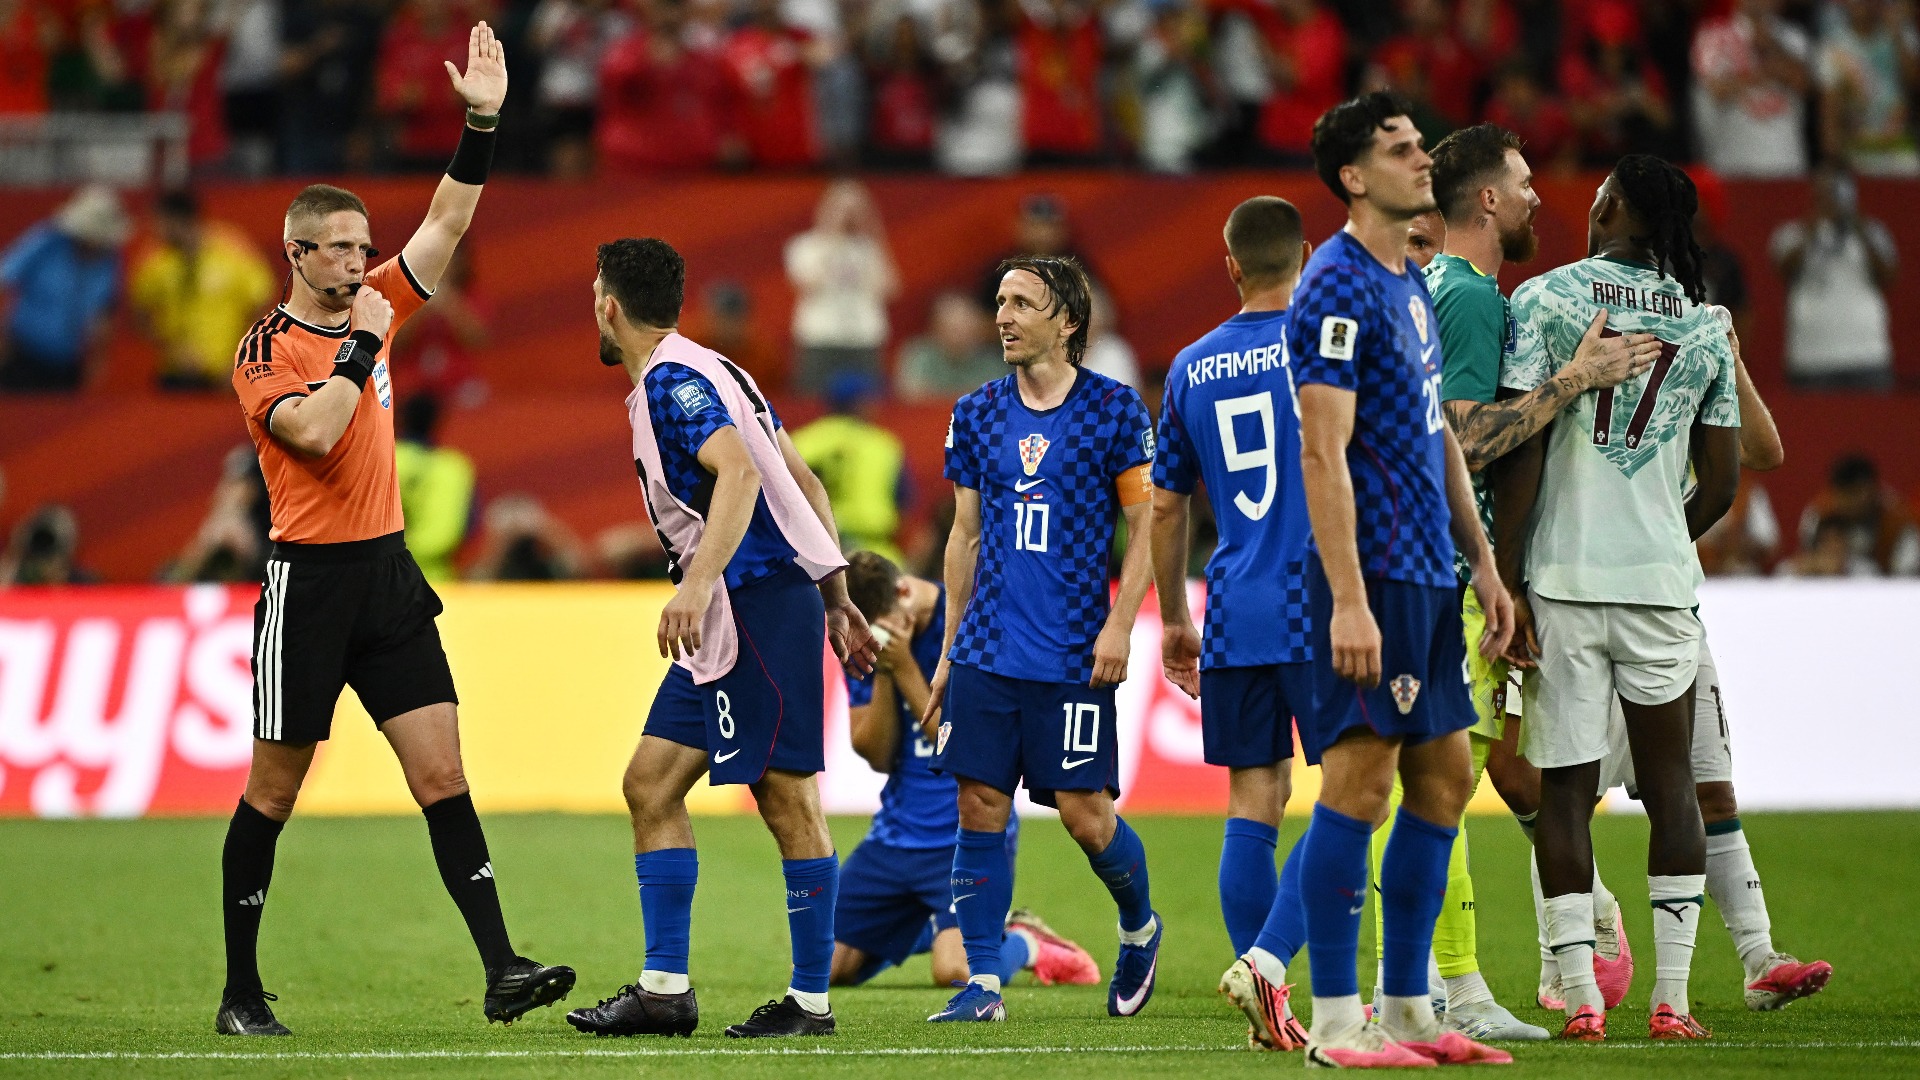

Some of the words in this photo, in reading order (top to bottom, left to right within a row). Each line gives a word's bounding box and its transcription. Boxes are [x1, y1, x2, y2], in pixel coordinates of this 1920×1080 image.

[1592, 281, 1637, 310] RAFA
[244, 363, 272, 380] FIFA
[372, 363, 387, 381] FIFA
[1591, 326, 1682, 450] 17
[1214, 391, 1278, 521] 9
[1013, 502, 1050, 553] 10
[716, 689, 735, 739] 8
[1063, 702, 1100, 752] 10
